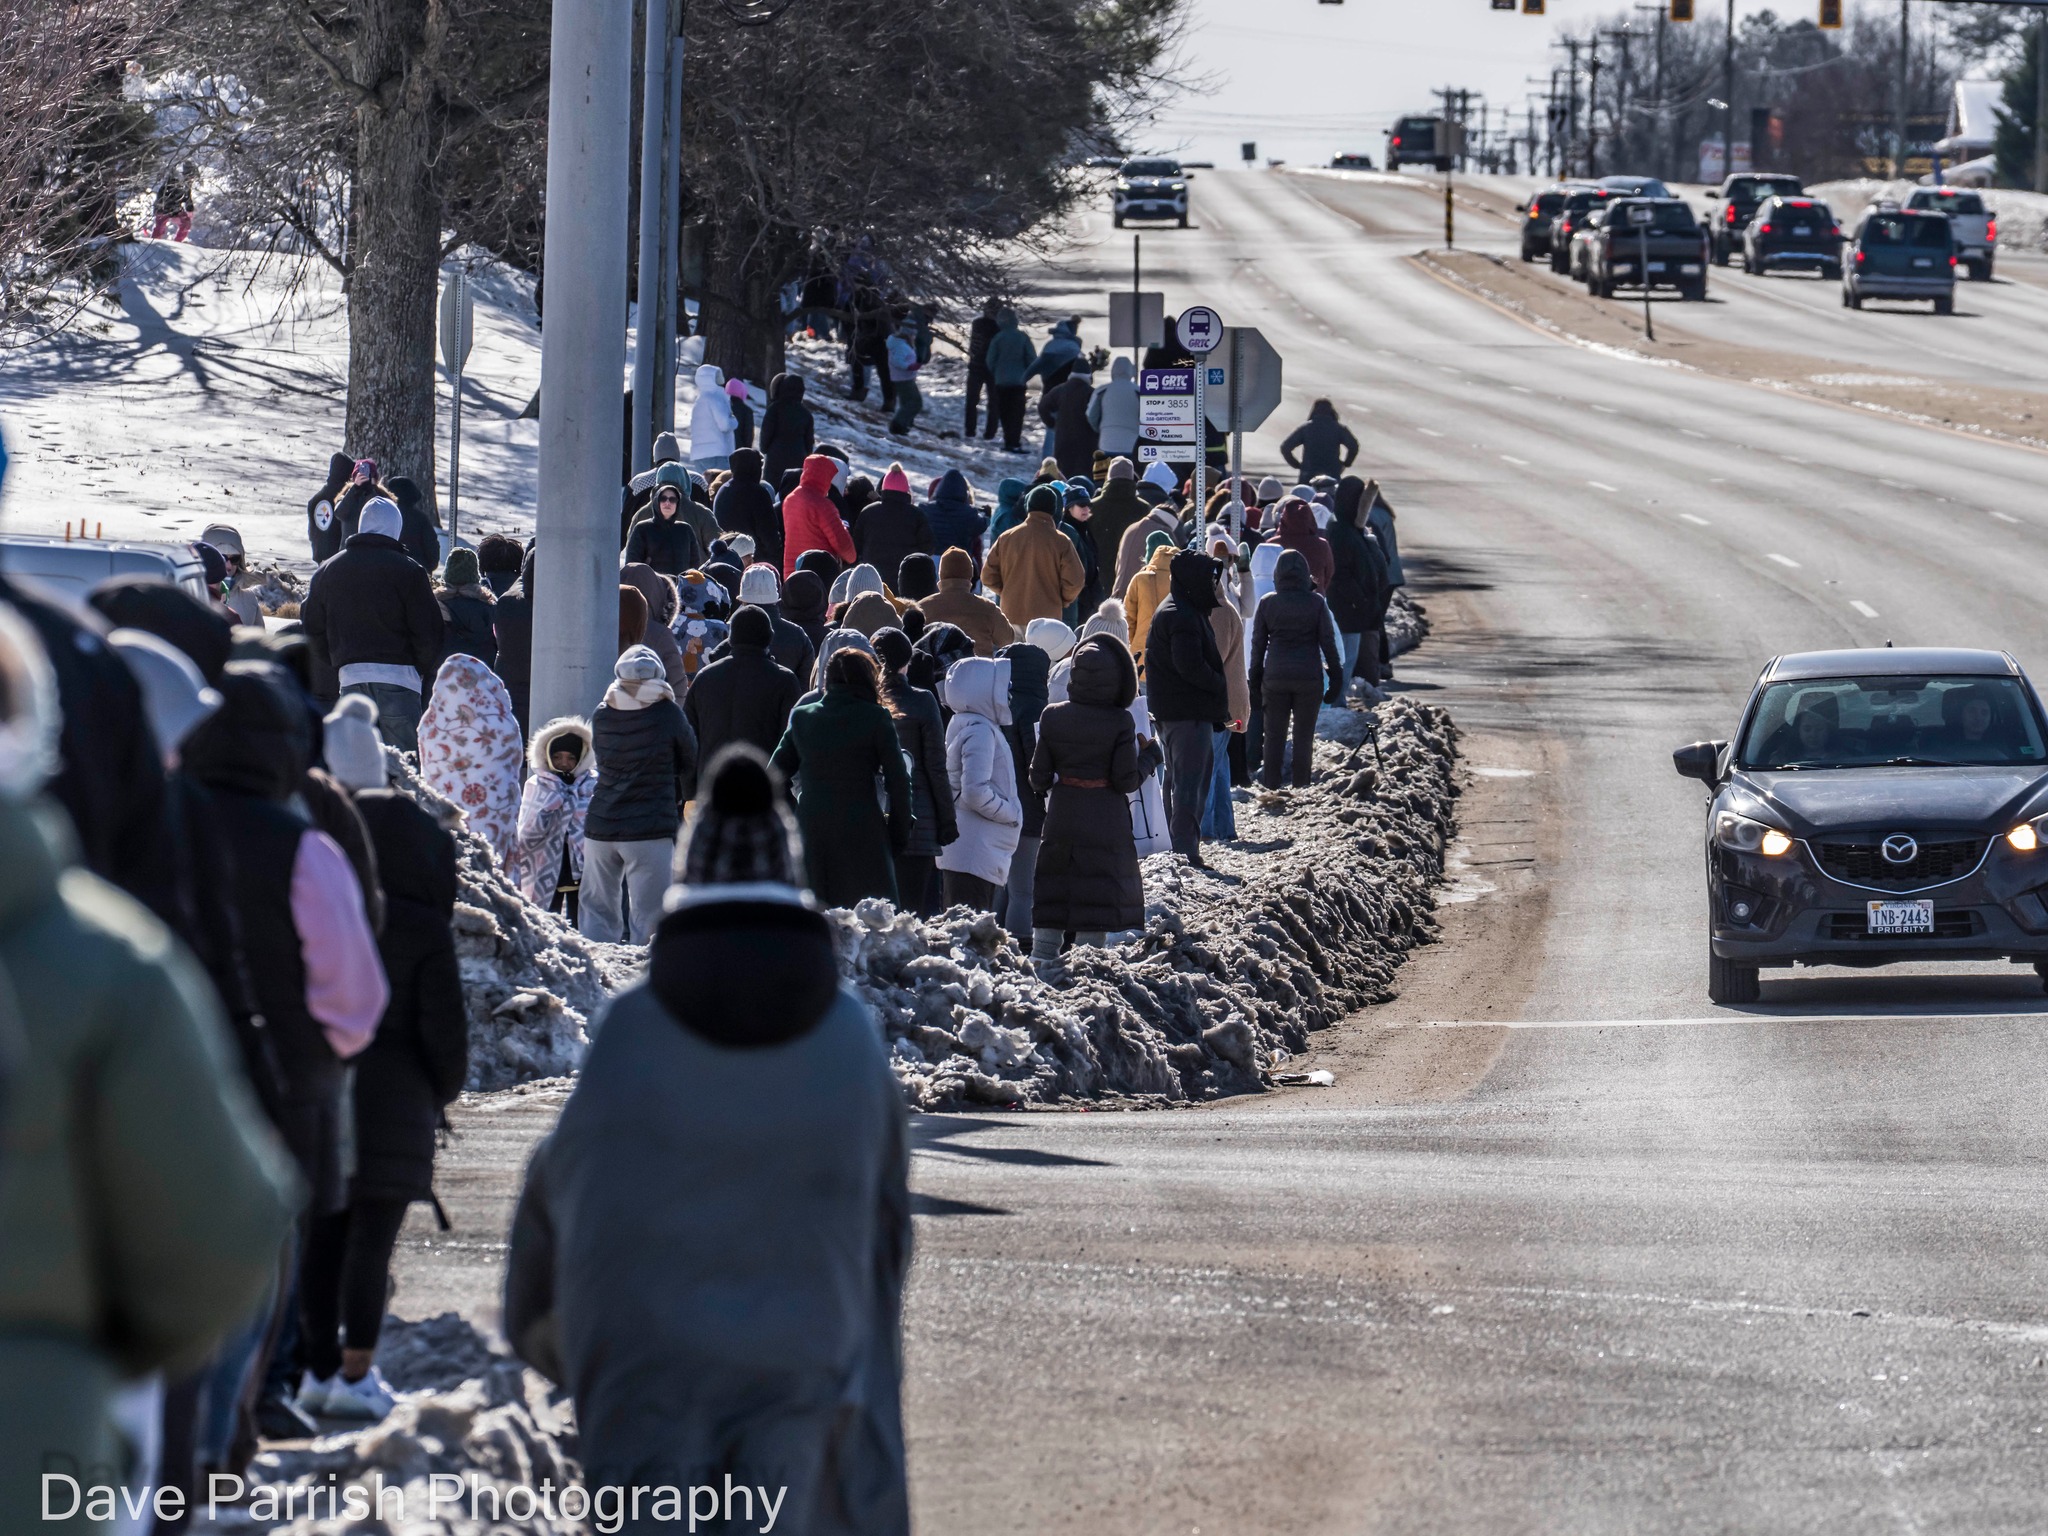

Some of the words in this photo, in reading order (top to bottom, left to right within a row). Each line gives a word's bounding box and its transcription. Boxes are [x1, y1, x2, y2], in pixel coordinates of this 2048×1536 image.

[1188, 339, 1210, 348] GRTC
[1162, 375, 1188, 387] GRTC
[1168, 399, 1188, 408] 3855
[1143, 447, 1157, 457] 3B
[1873, 909, 1930, 925] TNB-2443
